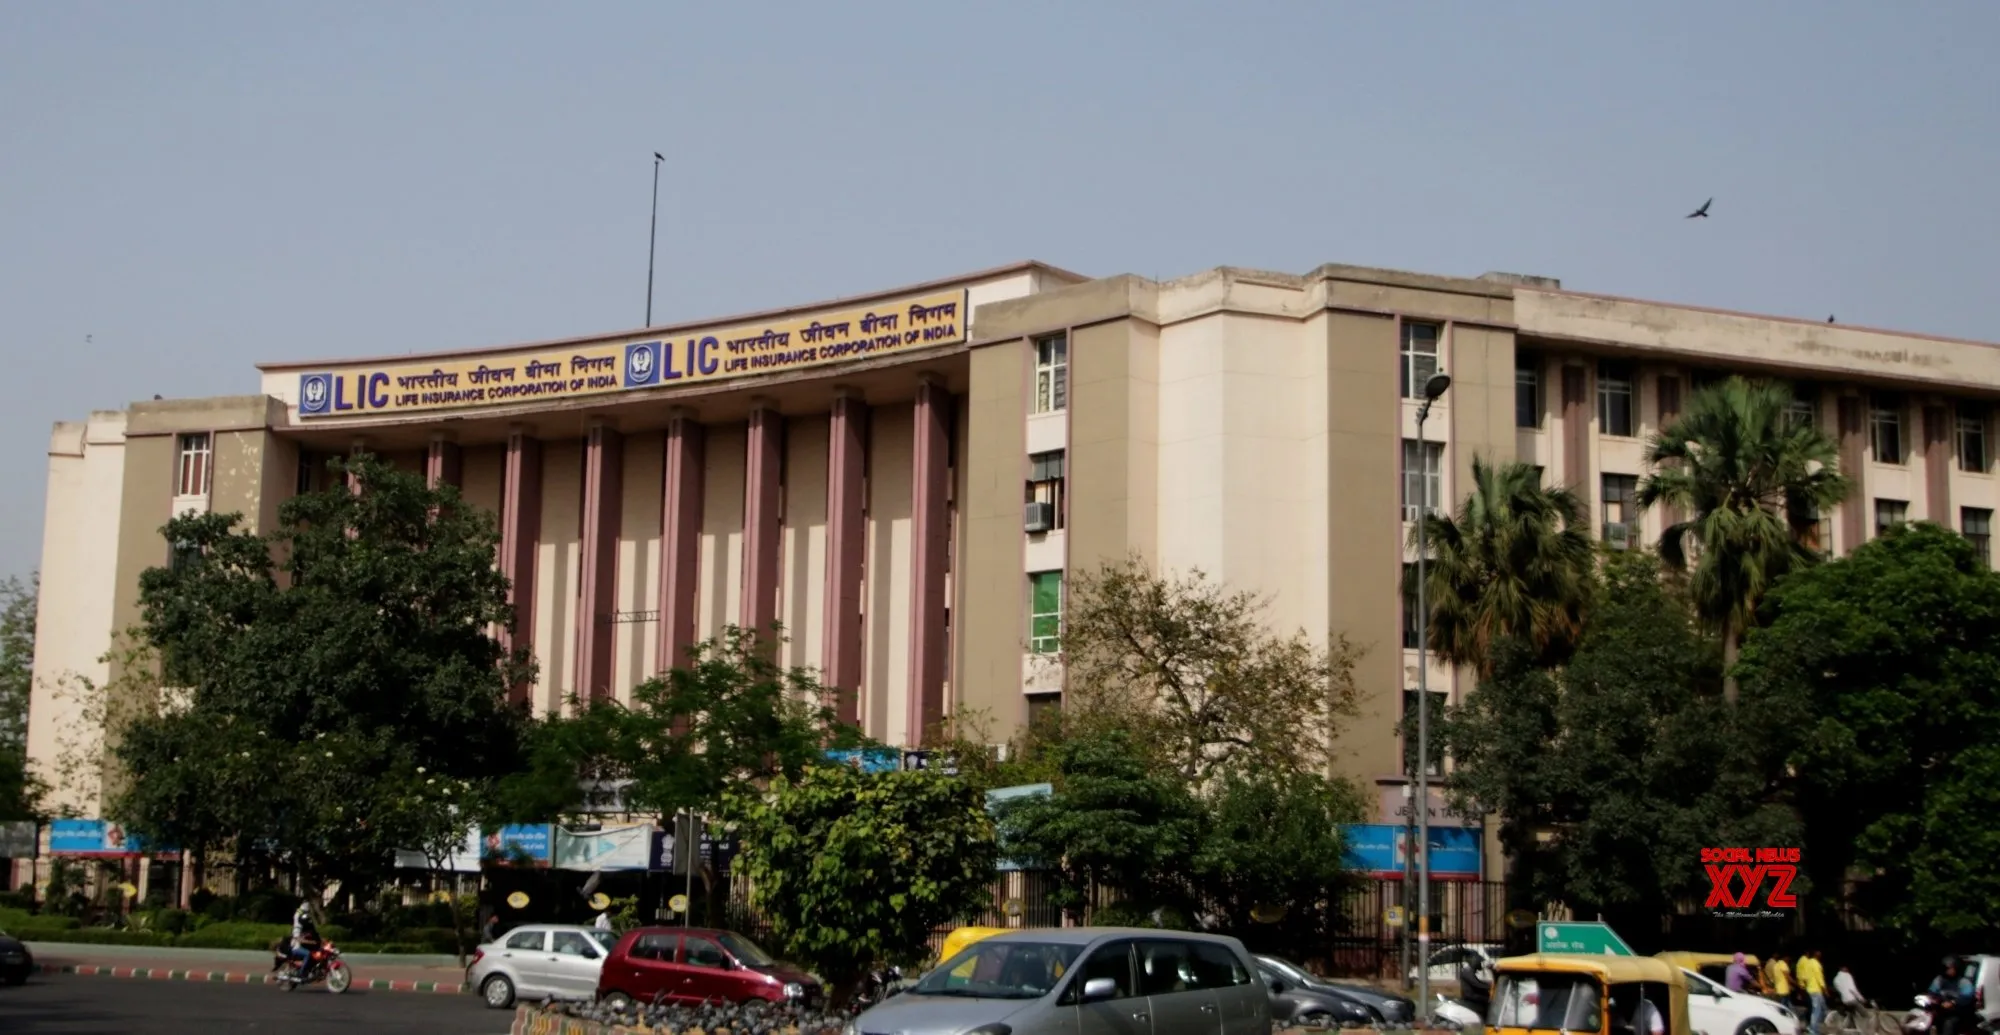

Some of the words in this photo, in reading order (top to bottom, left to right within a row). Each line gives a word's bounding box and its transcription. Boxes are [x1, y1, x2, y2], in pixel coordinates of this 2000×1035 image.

[724, 357, 748, 372] LIFE
[751, 348, 817, 368] INSURANCE
[819, 333, 901, 359] CORPORATION
[904, 329, 920, 344] OF
[923, 323, 956, 342] INDIA
[726, 329, 790, 354] भारतीय
[799, 321, 850, 343] जीवन
[859, 312, 898, 334] बीमा
[908, 302, 956, 326] निगम
[397, 368, 459, 390] भारतीय
[467, 364, 516, 385] जीवन
[524, 359, 562, 379] बीमा
[570, 355, 616, 375] निगम
[664, 336, 719, 380] LIC
[335, 372, 390, 410] LIC
[395, 393, 419, 407] LIFE
[422, 388, 485, 404] INSURANCE
[487, 380, 567, 399] CORPORATION
[569, 378, 585, 391] OF
[587, 374, 618, 389] INDIA
